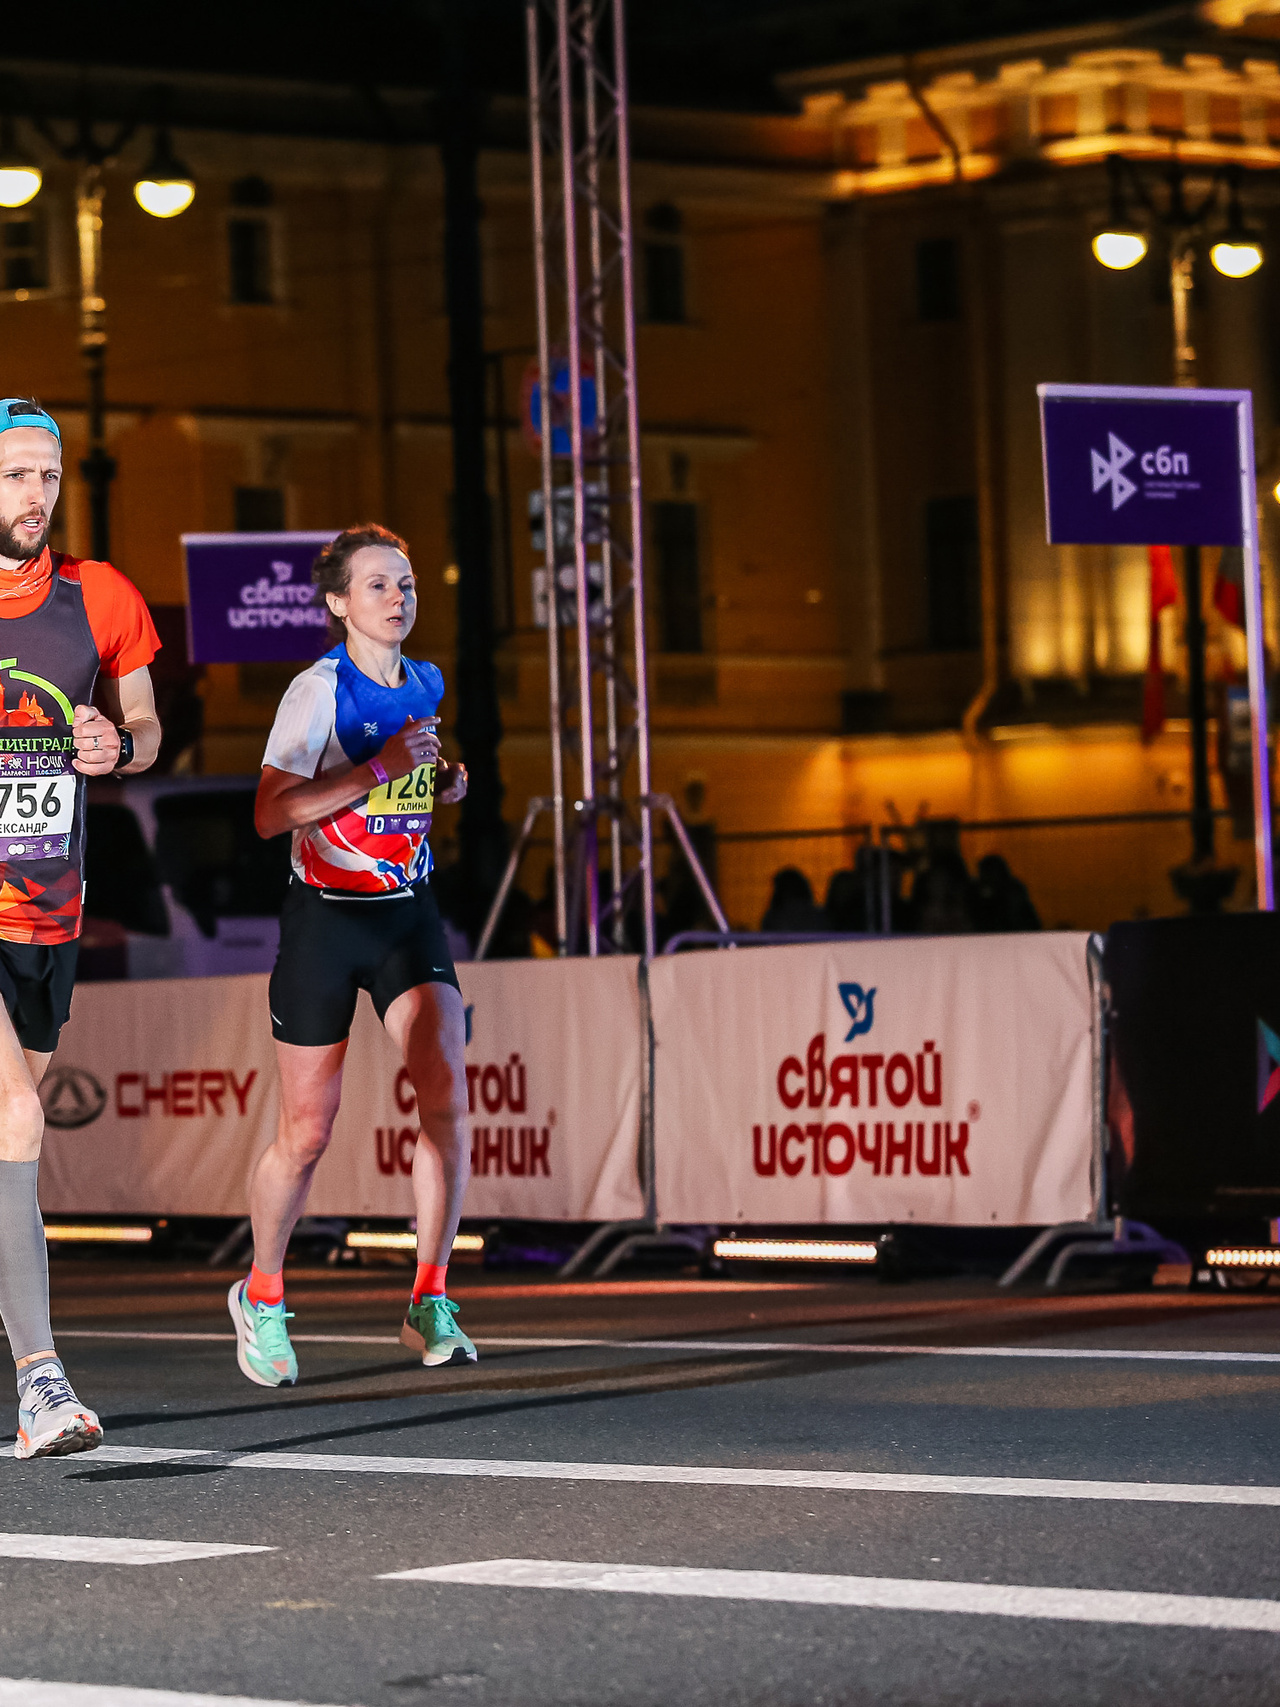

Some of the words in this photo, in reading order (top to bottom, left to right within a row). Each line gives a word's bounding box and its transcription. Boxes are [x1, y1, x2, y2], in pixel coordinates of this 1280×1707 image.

[26, 755, 65, 770] НОЧИ
[396, 802, 428, 811] ГАЛИНА
[373, 816, 385, 834] D
[116, 1069, 258, 1117] CHERY
